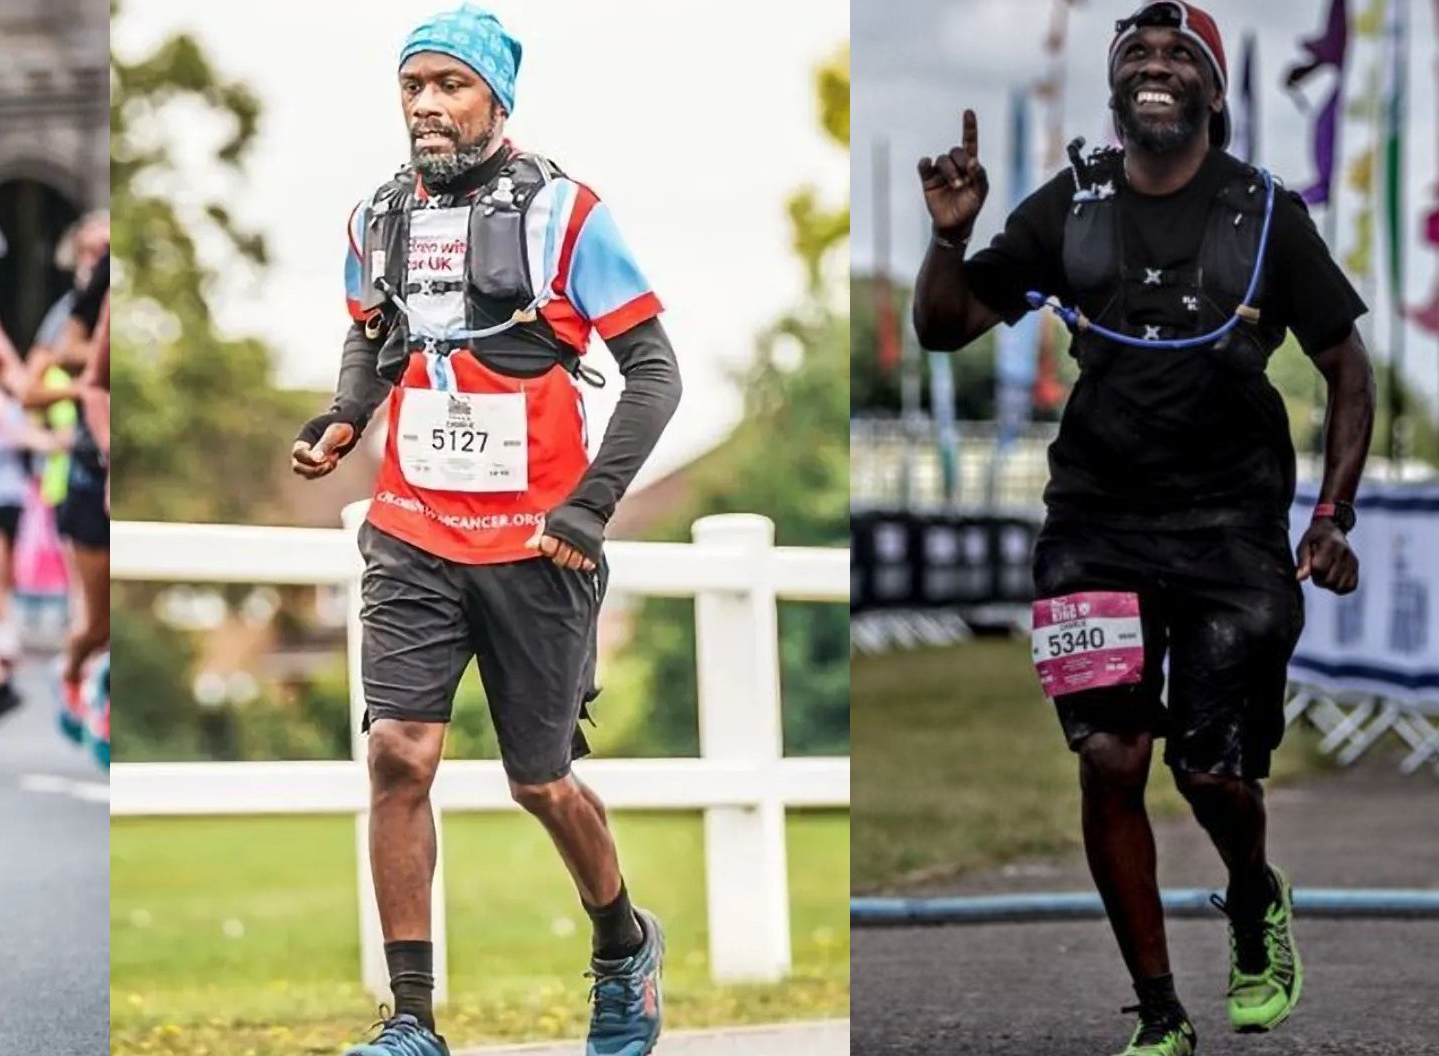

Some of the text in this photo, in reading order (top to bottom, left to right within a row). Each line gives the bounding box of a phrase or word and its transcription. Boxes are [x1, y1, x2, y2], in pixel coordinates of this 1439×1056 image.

[428, 256, 453, 272] UK
[431, 428, 489, 453] 5127
[1048, 627, 1105, 657] 5340
